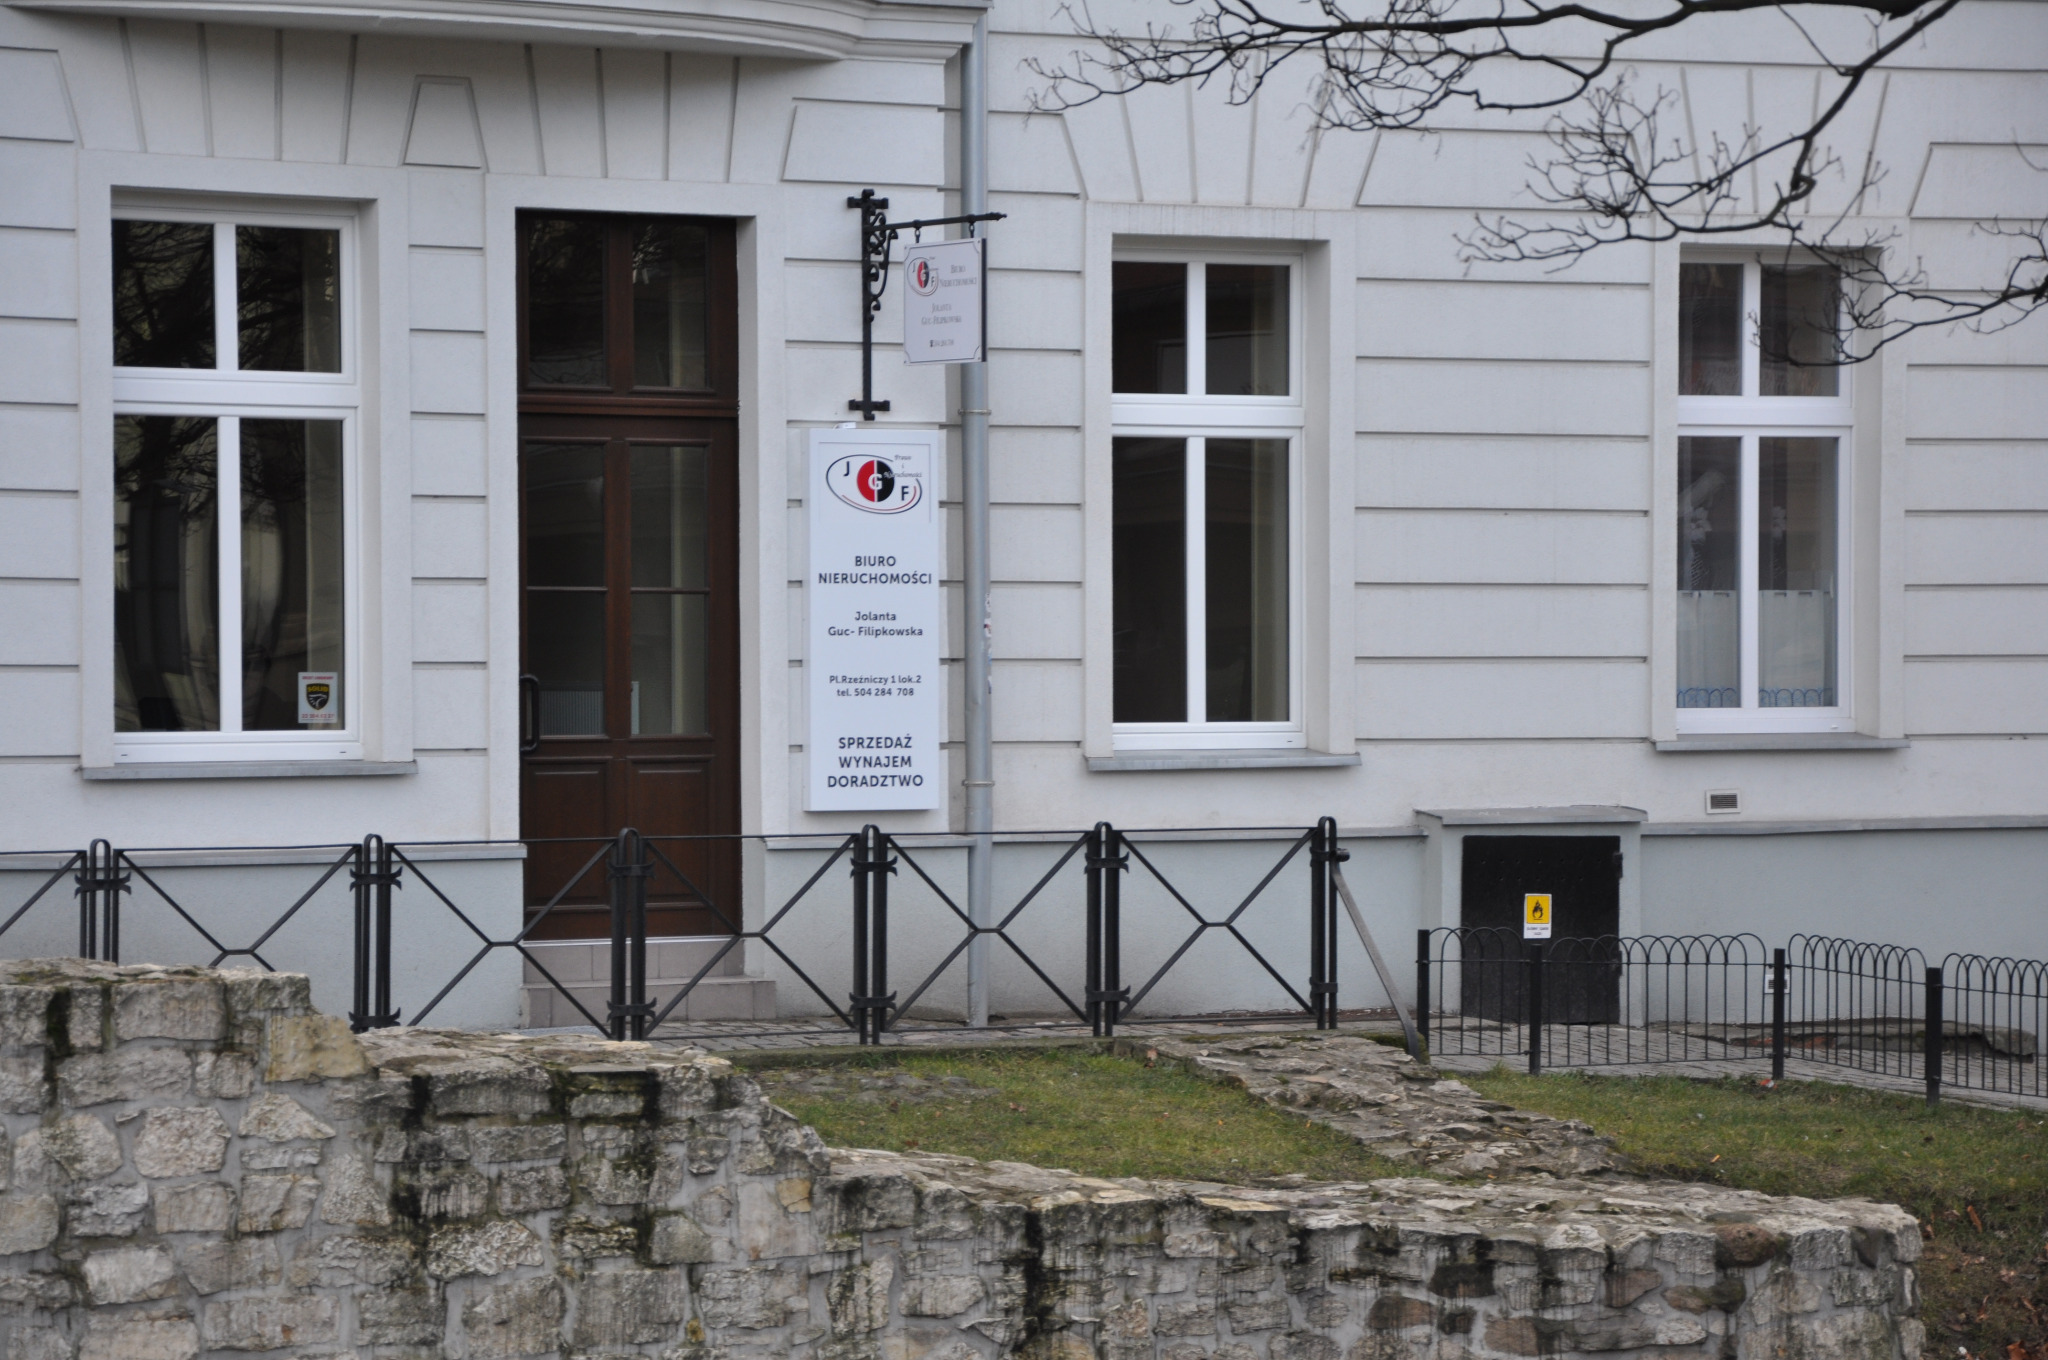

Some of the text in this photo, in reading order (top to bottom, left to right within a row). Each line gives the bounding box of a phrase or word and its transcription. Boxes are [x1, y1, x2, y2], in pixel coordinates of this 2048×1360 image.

[843, 461, 850, 477] J
[868, 473, 883, 490] G
[901, 486, 909, 501] F
[855, 555, 896, 567] BIURO
[818, 570, 932, 584] NIERUCHOMOŚCI
[854, 611, 896, 622] Jolanta
[858, 626, 923, 638] Filipkowska
[890, 675, 896, 684] 1
[898, 675, 922, 684] lok.2
[837, 688, 914, 697] tel. 504 284 708
[838, 734, 912, 749] SPRZEDAŻ
[839, 756, 912, 768] WYNAJEM
[828, 774, 924, 788] DORADZTWO
